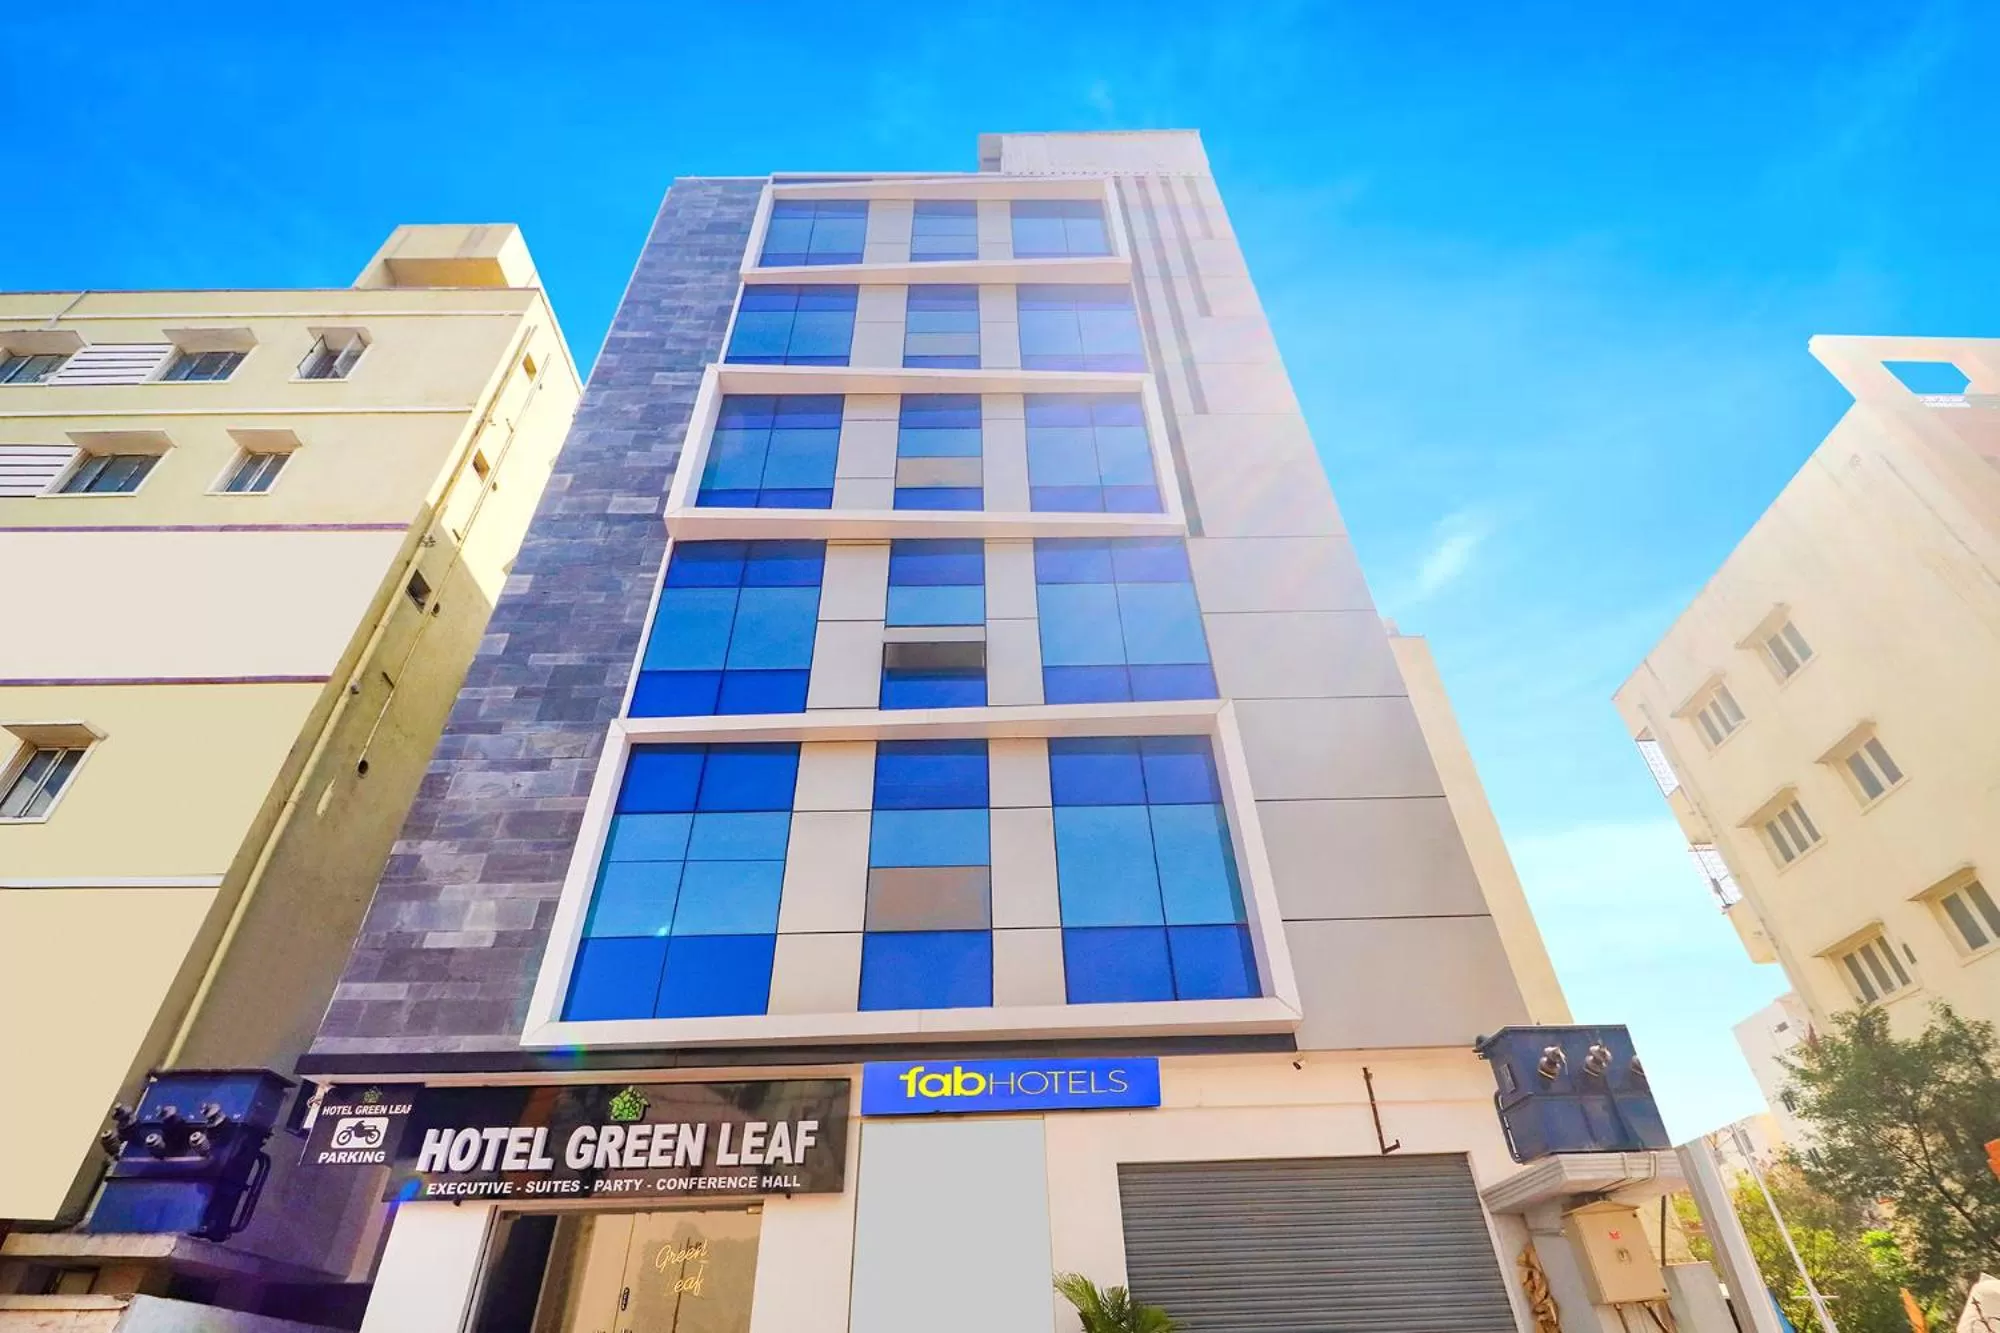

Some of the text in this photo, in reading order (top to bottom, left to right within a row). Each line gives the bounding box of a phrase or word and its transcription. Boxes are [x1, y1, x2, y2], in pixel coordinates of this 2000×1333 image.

[322, 1104, 413, 1115] HOTEL GREEN LEAF
[415, 1120, 819, 1171] HOTEL GREEN LEAF
[318, 1151, 386, 1164] PARKING
[426, 1181, 512, 1195] EXECUTIVE
[525, 1179, 581, 1194] SUITES
[593, 1178, 643, 1193] PARTY
[656, 1176, 759, 1191] CONFERENCE
[762, 1174, 801, 1188] HALL
[655, 1239, 708, 1273] Green
